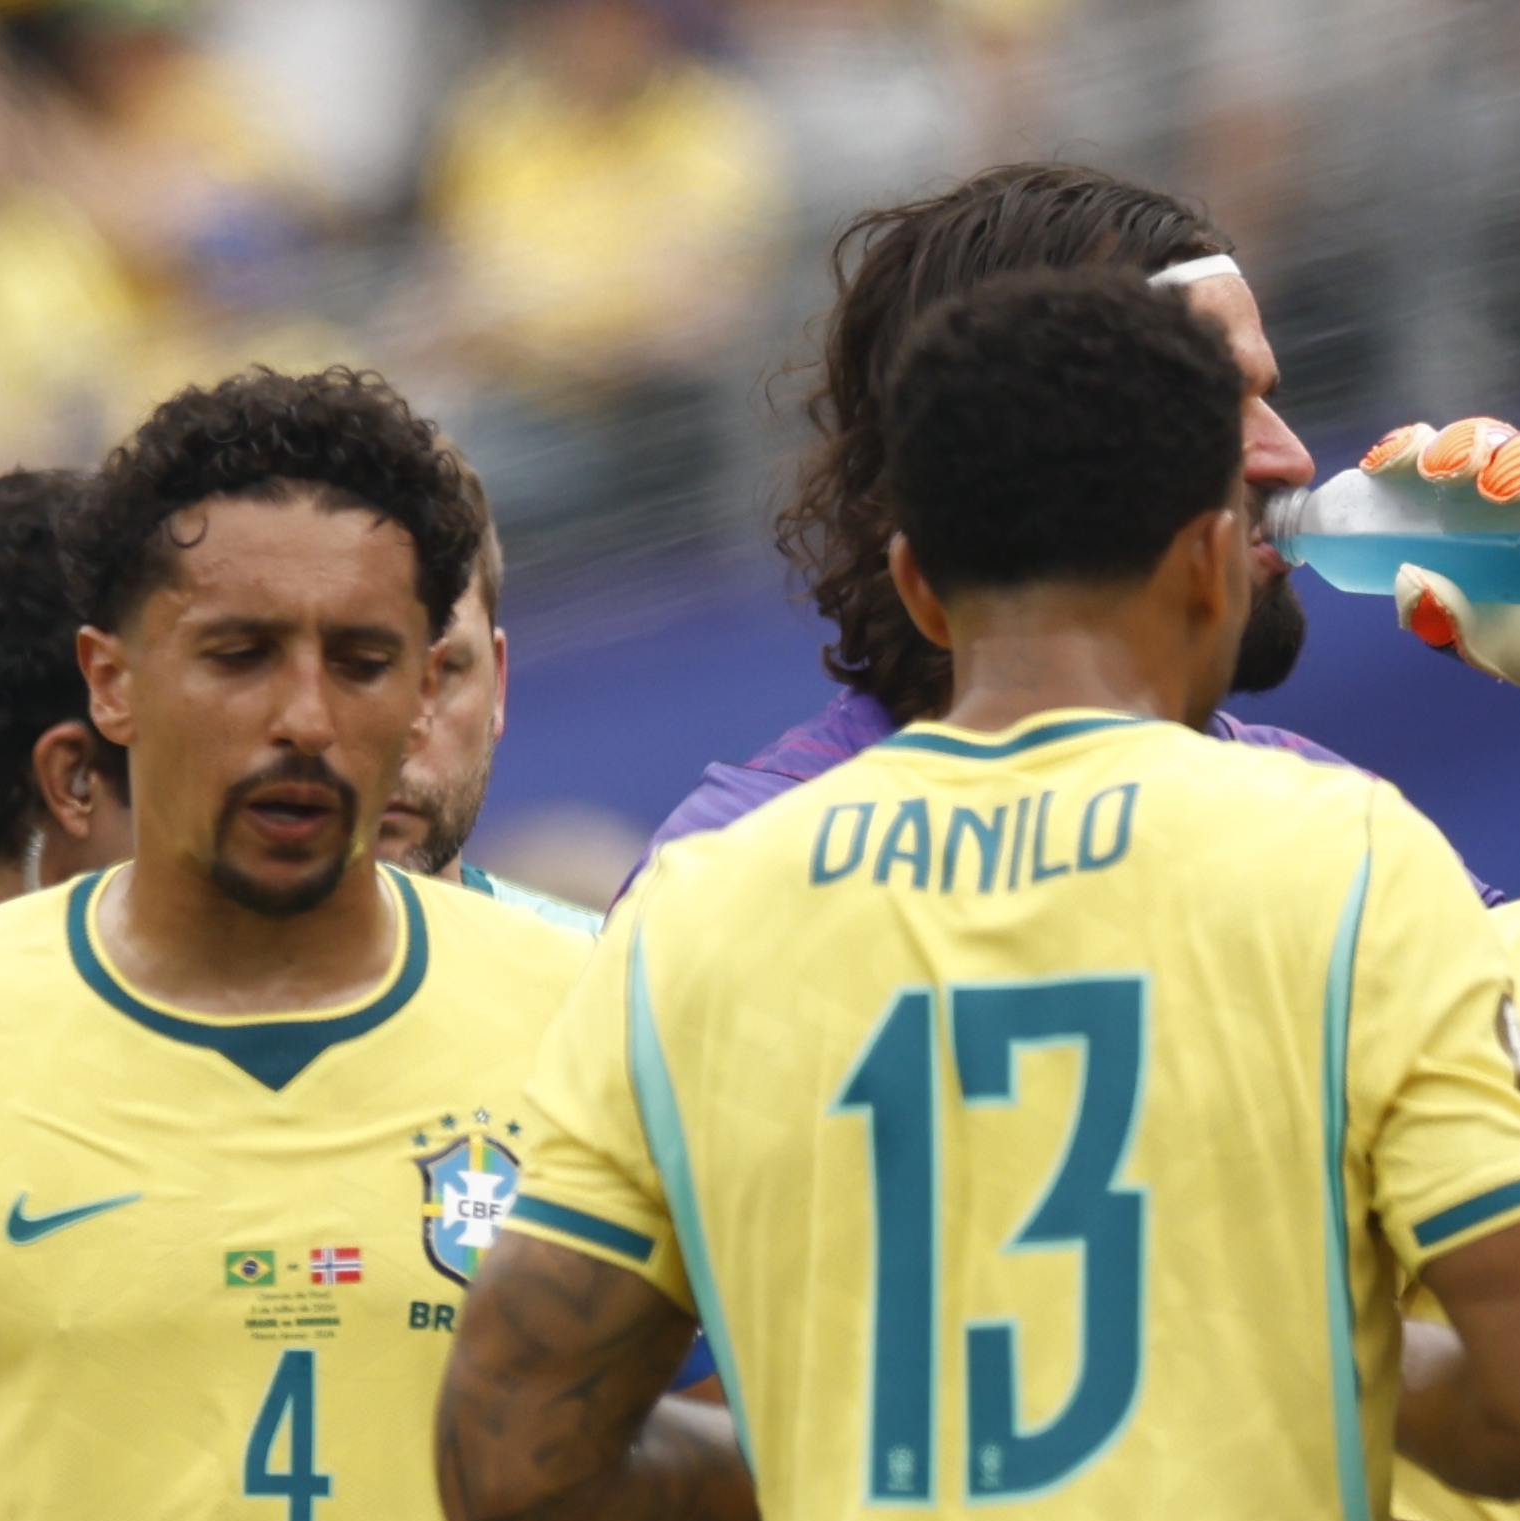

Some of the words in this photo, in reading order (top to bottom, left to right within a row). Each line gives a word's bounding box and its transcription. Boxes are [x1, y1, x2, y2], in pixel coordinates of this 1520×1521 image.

[809, 781, 1141, 895] DANILO
[457, 1199, 503, 1220] CBF
[827, 971, 1153, 1512] 13
